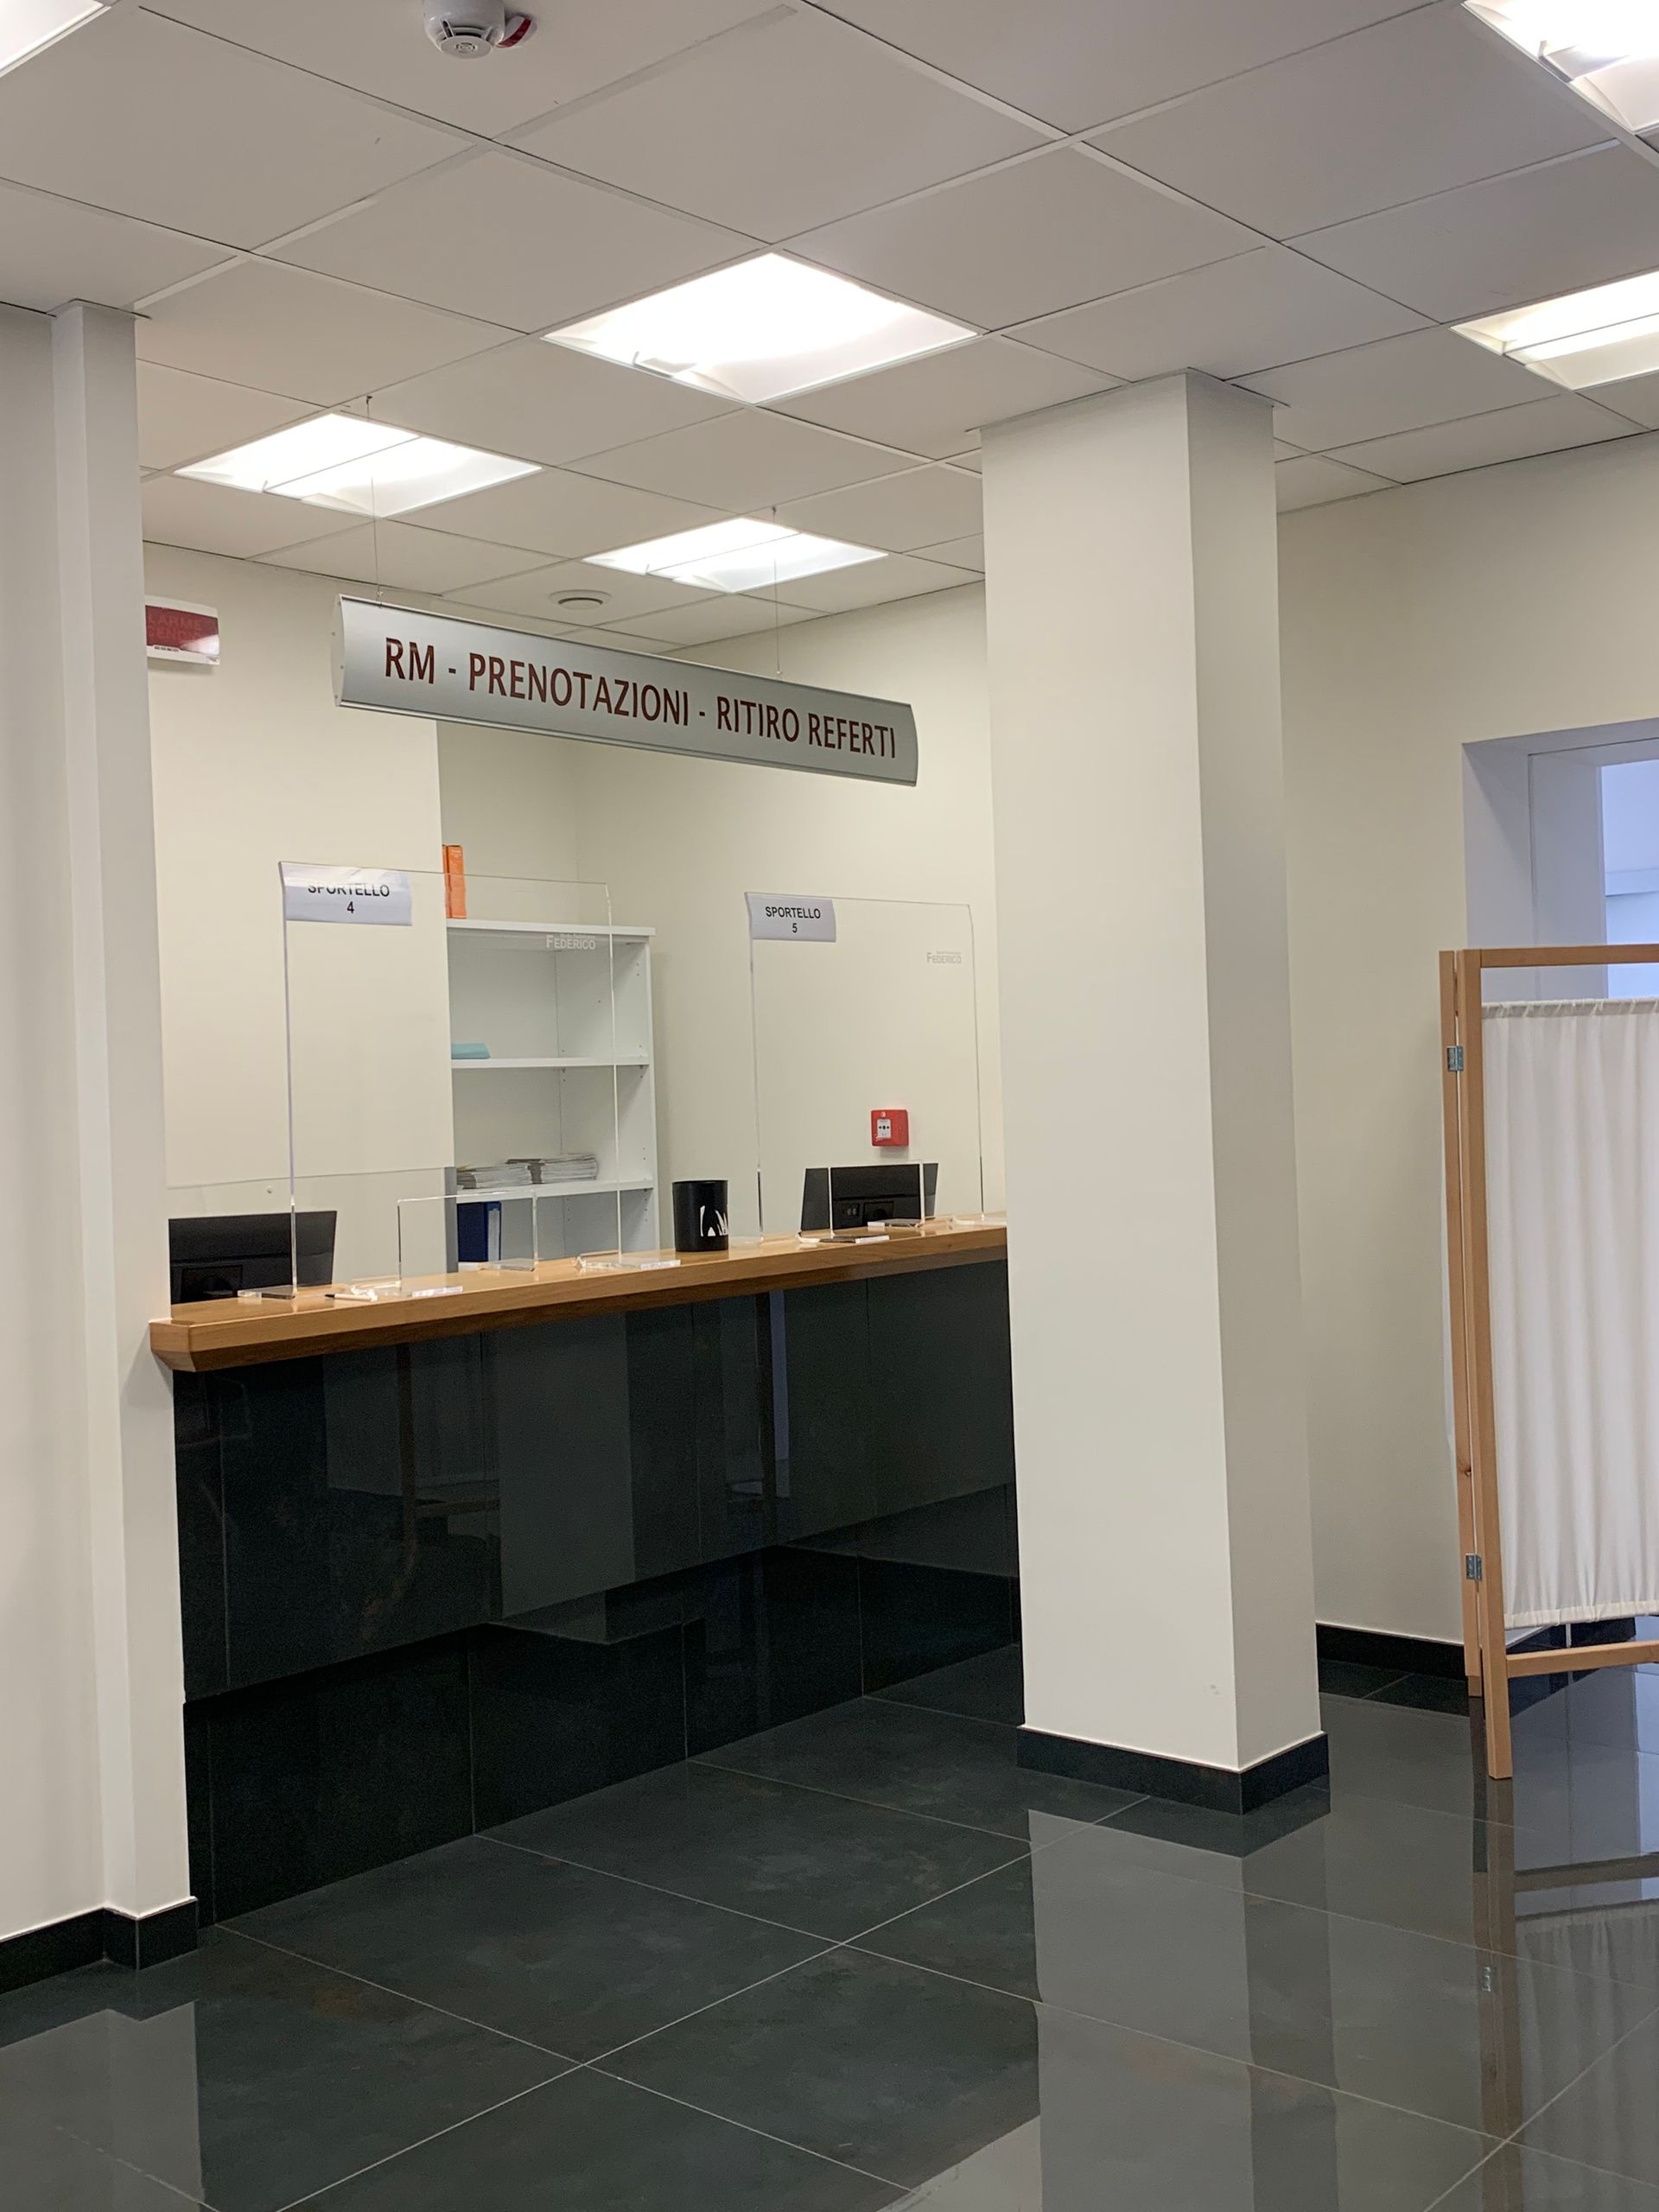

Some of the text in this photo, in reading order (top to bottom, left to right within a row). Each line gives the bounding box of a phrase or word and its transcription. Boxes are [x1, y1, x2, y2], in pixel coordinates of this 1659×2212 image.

[385, 637, 435, 684] RM
[469, 652, 690, 727] PRENOTAZIONI
[716, 696, 800, 743] RITIRO
[807, 712, 896, 759] REFERTI
[346, 901, 355, 914] 4
[765, 906, 821, 919] SPORTELLO
[791, 922, 798, 933] 5
[545, 934, 596, 950] FEDERICO
